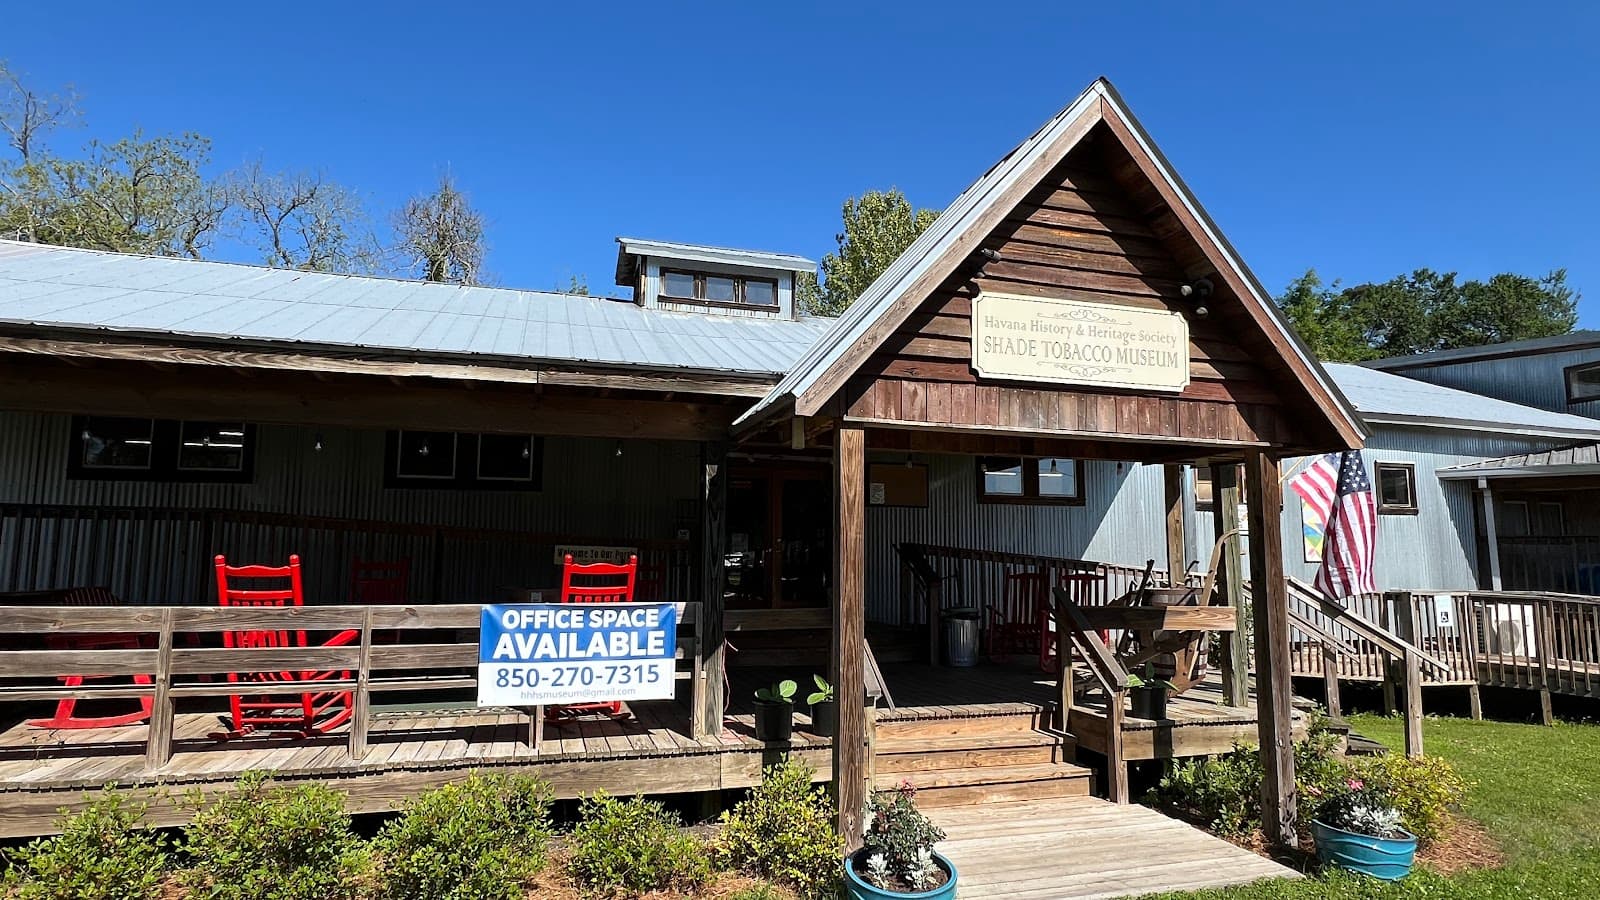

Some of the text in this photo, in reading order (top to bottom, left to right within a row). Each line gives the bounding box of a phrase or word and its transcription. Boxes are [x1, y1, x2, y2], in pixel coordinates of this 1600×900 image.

[985, 315, 1177, 348] Havana History & Heritage Society
[984, 335, 1179, 368] SHADE TOBACCO MUSEUM
[502, 608, 659, 629] OFFICE SPACE
[493, 630, 666, 660] AVAILABLE
[496, 664, 660, 688] 850-270-7315
[520, 687, 636, 700] hhhsmuseum@gmail.com
